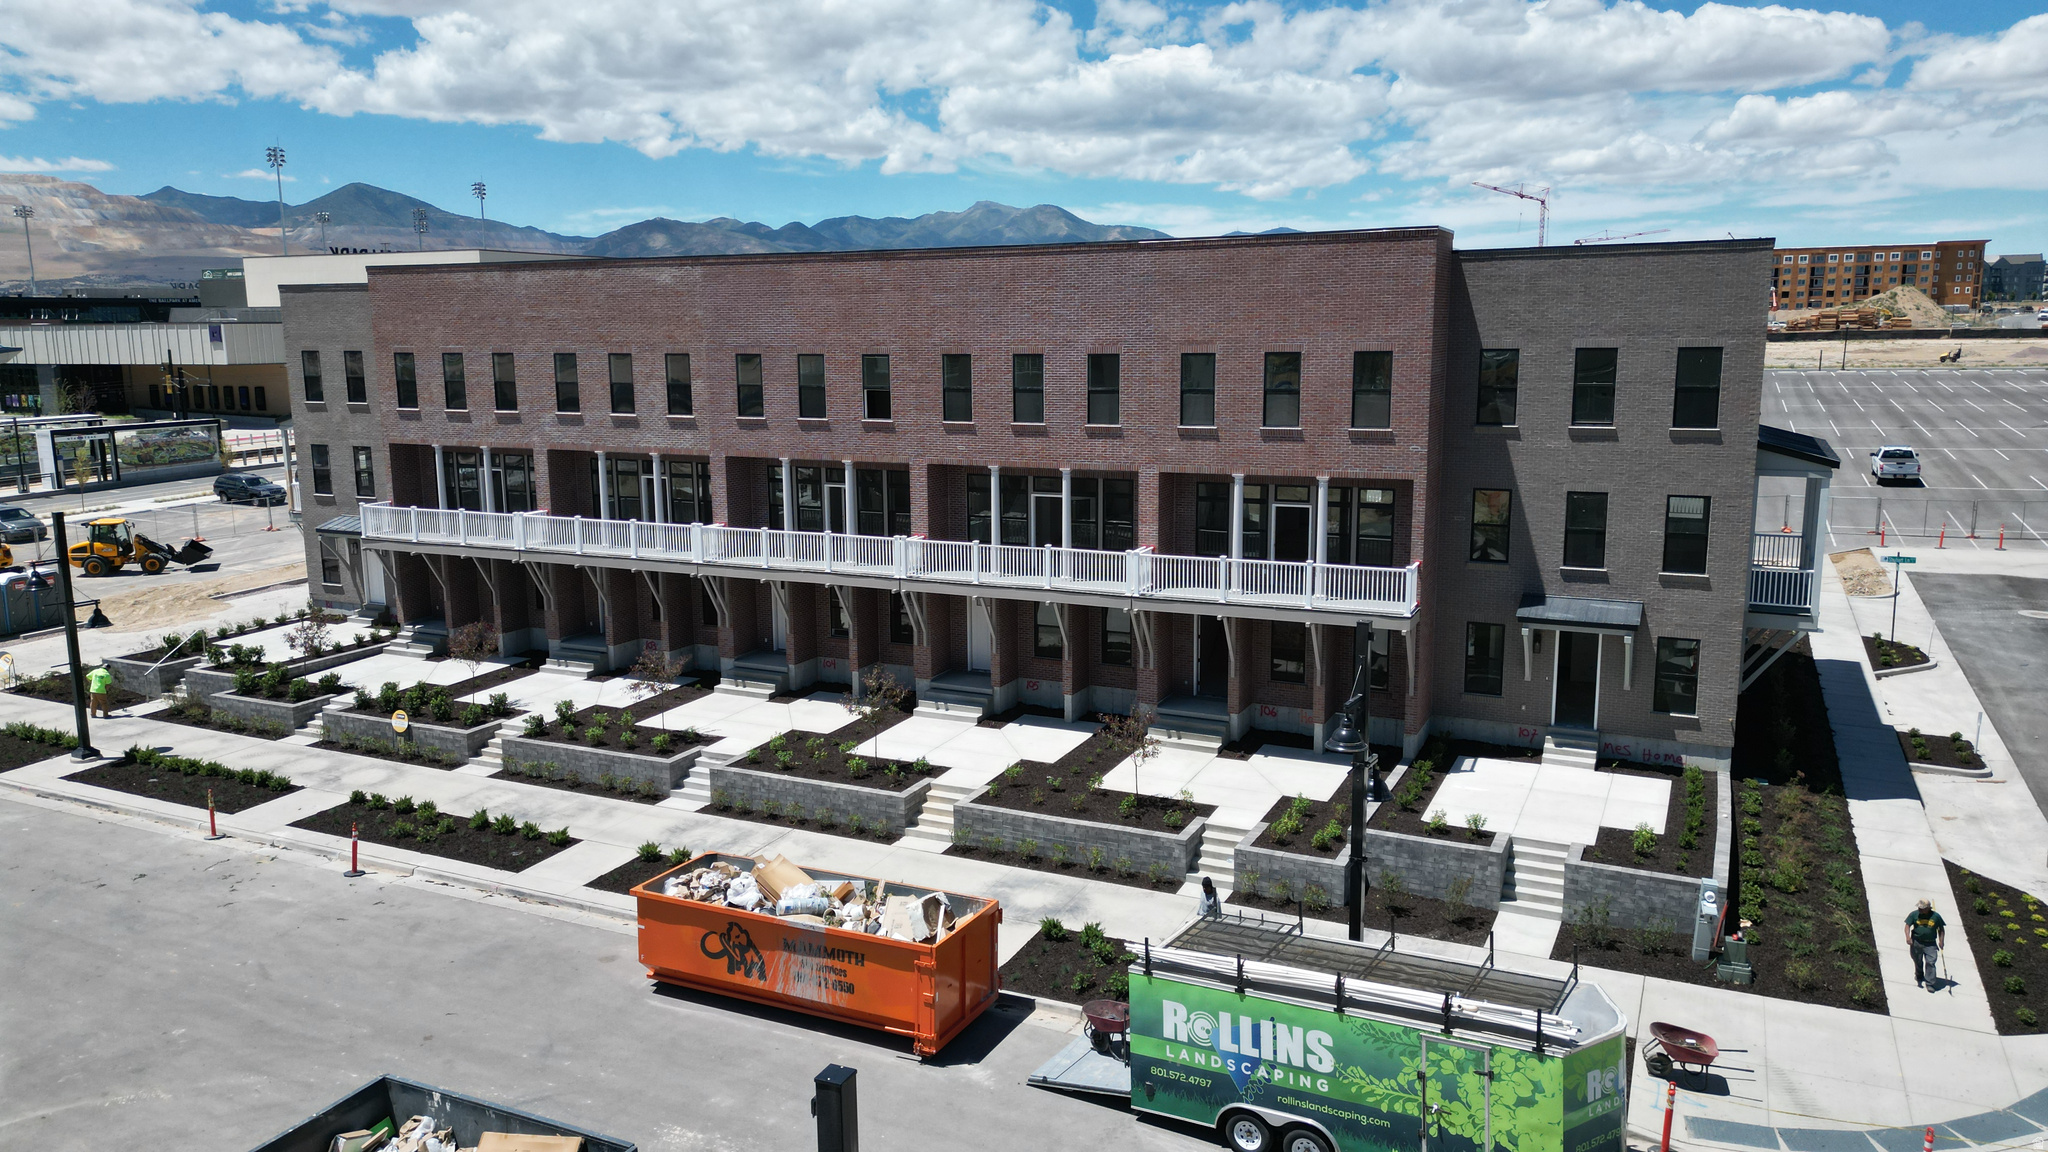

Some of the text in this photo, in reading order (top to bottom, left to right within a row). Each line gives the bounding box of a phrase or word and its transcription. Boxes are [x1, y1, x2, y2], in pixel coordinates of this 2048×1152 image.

[158, 550, 172, 559] JCB
[823, 659, 836, 669] 104
[1026, 680, 1040, 691] 105
[1260, 705, 1278, 718] 106
[1518, 726, 1538, 743] 107
[783, 937, 865, 967] MAMMOTH
[1162, 999, 1334, 1074] ROLLINS
[1150, 1066, 1212, 1088] 801.572.4797
[1165, 1045, 1329, 1092] LANDSCAPING
[1277, 1095, 1391, 1128] rollinslandscaping.com
